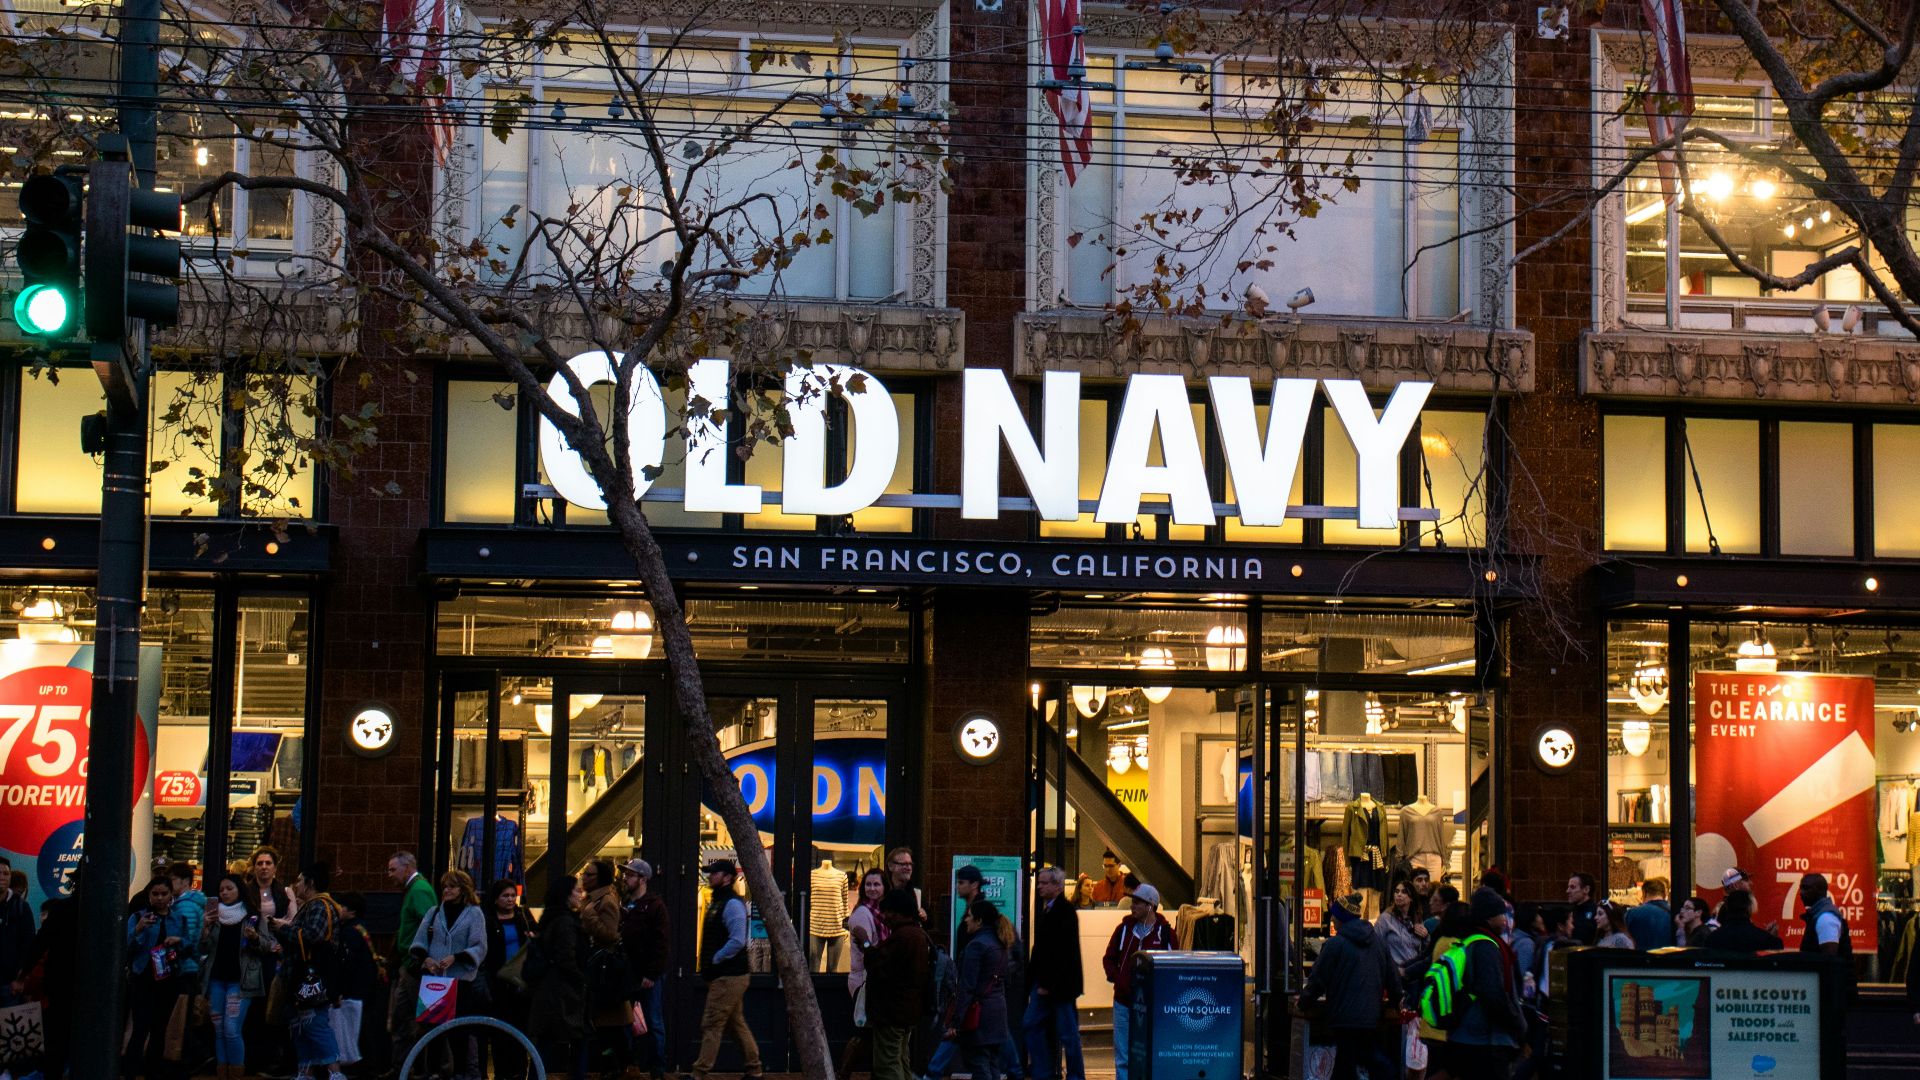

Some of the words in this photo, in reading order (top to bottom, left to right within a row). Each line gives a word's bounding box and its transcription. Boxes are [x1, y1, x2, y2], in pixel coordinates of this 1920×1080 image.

[539, 350, 899, 515] OLD
[961, 368, 1435, 529] NAVY
[733, 546, 800, 568] SAN
[821, 548, 1032, 578] FRANCISCO,
[1051, 554, 1262, 580] CALIFORNIA
[39, 685, 53, 695] UP
[55, 685, 68, 695] TO
[1710, 683, 1739, 696] THE
[1709, 700, 1847, 723] CLEARANCE
[1710, 724, 1756, 737] EVENT
[0, 704, 91, 777] 75
[160, 776, 196, 796] 75%
[1114, 788, 1149, 803] ENIM
[57, 853, 82, 862] JEANS
[1775, 857, 1792, 870] UP
[1793, 858, 1810, 870] TO
[985, 887, 1001, 897] SH
[1716, 988, 1748, 1001] GIRL
[1753, 988, 1807, 1001] SCOUTS
[1164, 1005, 1194, 1014] UNION
[1196, 1005, 1231, 1015] SQUARE
[1716, 1003, 1776, 1014] MOBILIZES
[1777, 1004, 1811, 1014] THEIR
[1730, 1017, 1776, 1028] TROOPS
[1777, 1018, 1795, 1028] with
[1728, 1032, 1800, 1043] SALESFORCE.
